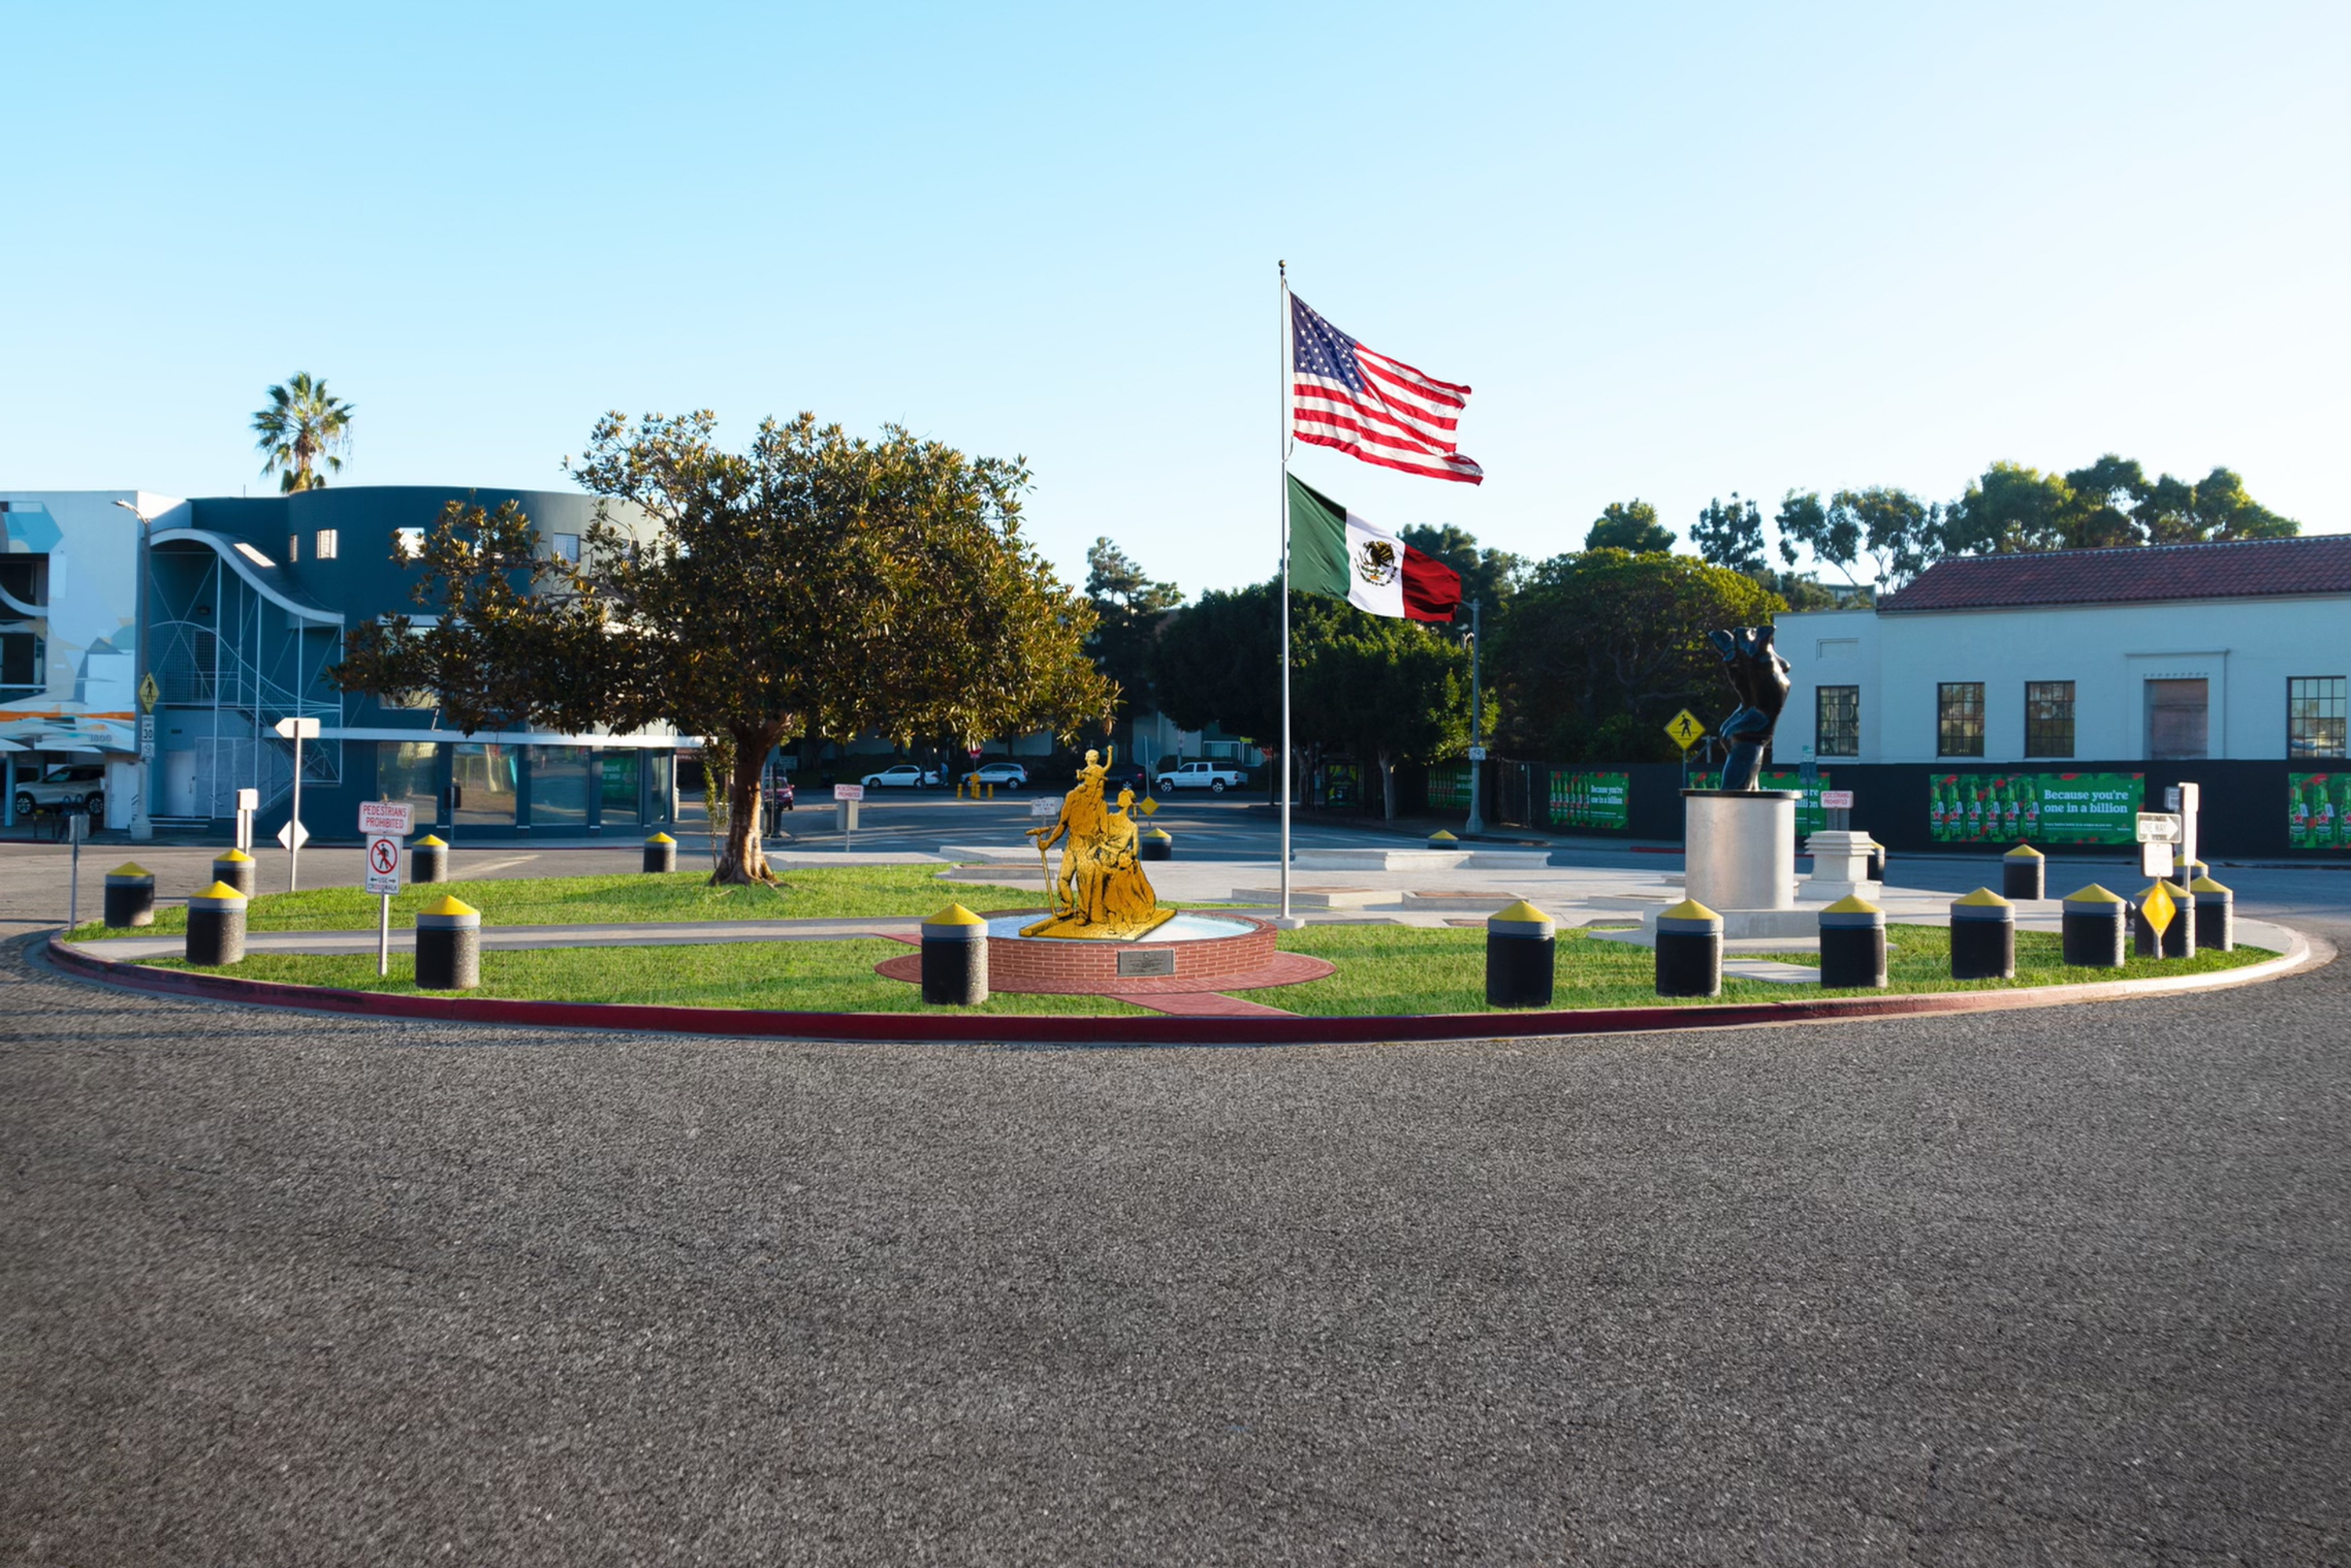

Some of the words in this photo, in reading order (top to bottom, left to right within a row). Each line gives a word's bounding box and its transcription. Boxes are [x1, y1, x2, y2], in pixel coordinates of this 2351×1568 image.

[143, 729, 153, 739] 30
[2044, 789, 2089, 800] Because
[2092, 790, 2128, 802] you're
[363, 805, 407, 817] PEDESTRIANS
[2044, 804, 2065, 813] one
[2067, 802, 2078, 813] in
[2080, 805, 2088, 813] a
[2090, 802, 2128, 813] billion
[366, 817, 404, 829] PROHIBITED
[2142, 822, 2153, 831] ONE
[2155, 822, 2167, 831] WAY
